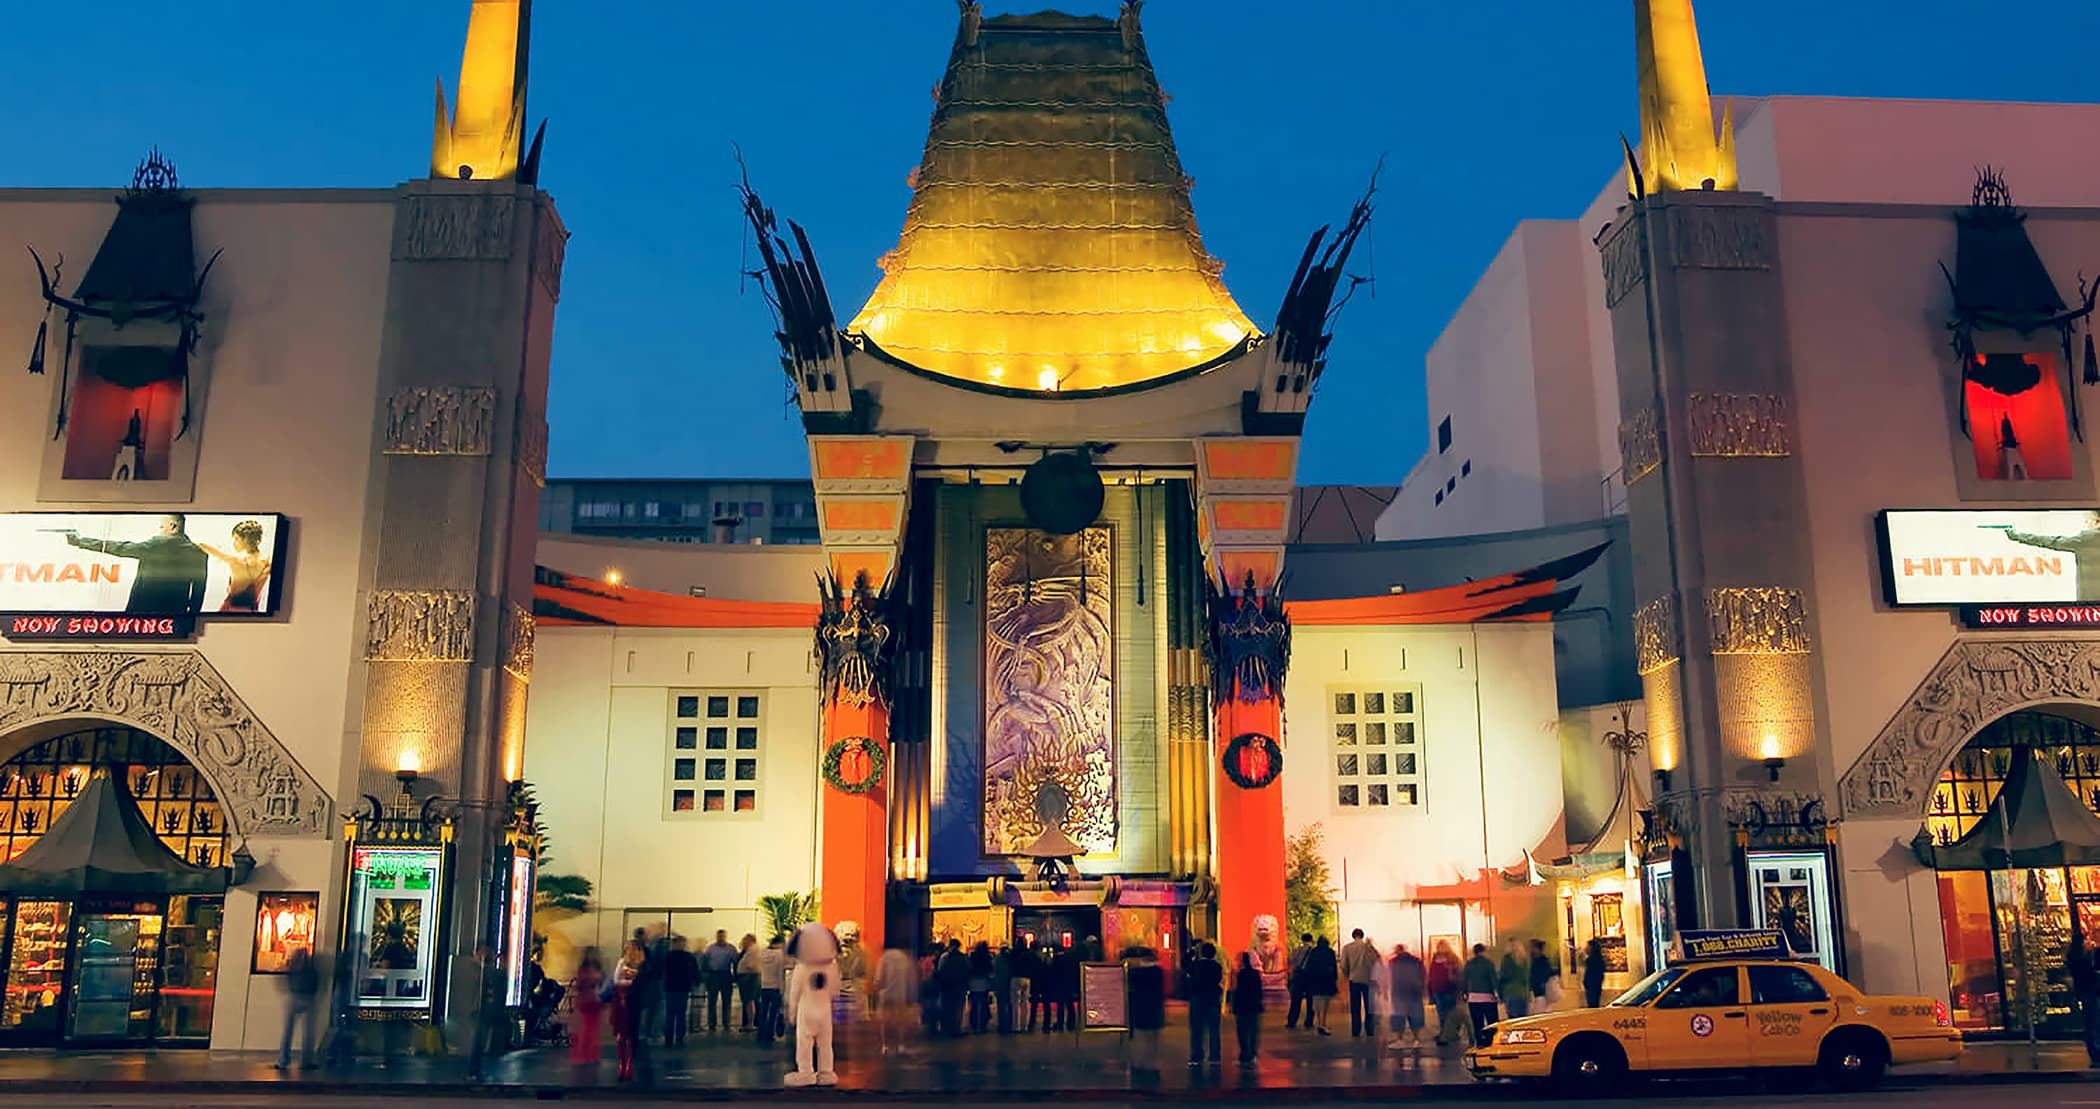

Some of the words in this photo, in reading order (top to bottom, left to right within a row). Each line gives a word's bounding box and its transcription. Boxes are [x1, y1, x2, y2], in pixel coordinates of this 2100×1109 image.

[1903, 557, 2062, 577] HITMAN
[1979, 608, 2020, 623] NOW
[13, 617, 61, 633] NOW
[67, 617, 174, 634] SHOWING
[1613, 1018, 1646, 1029] 6445
[1756, 1010, 1801, 1024] Yellow
